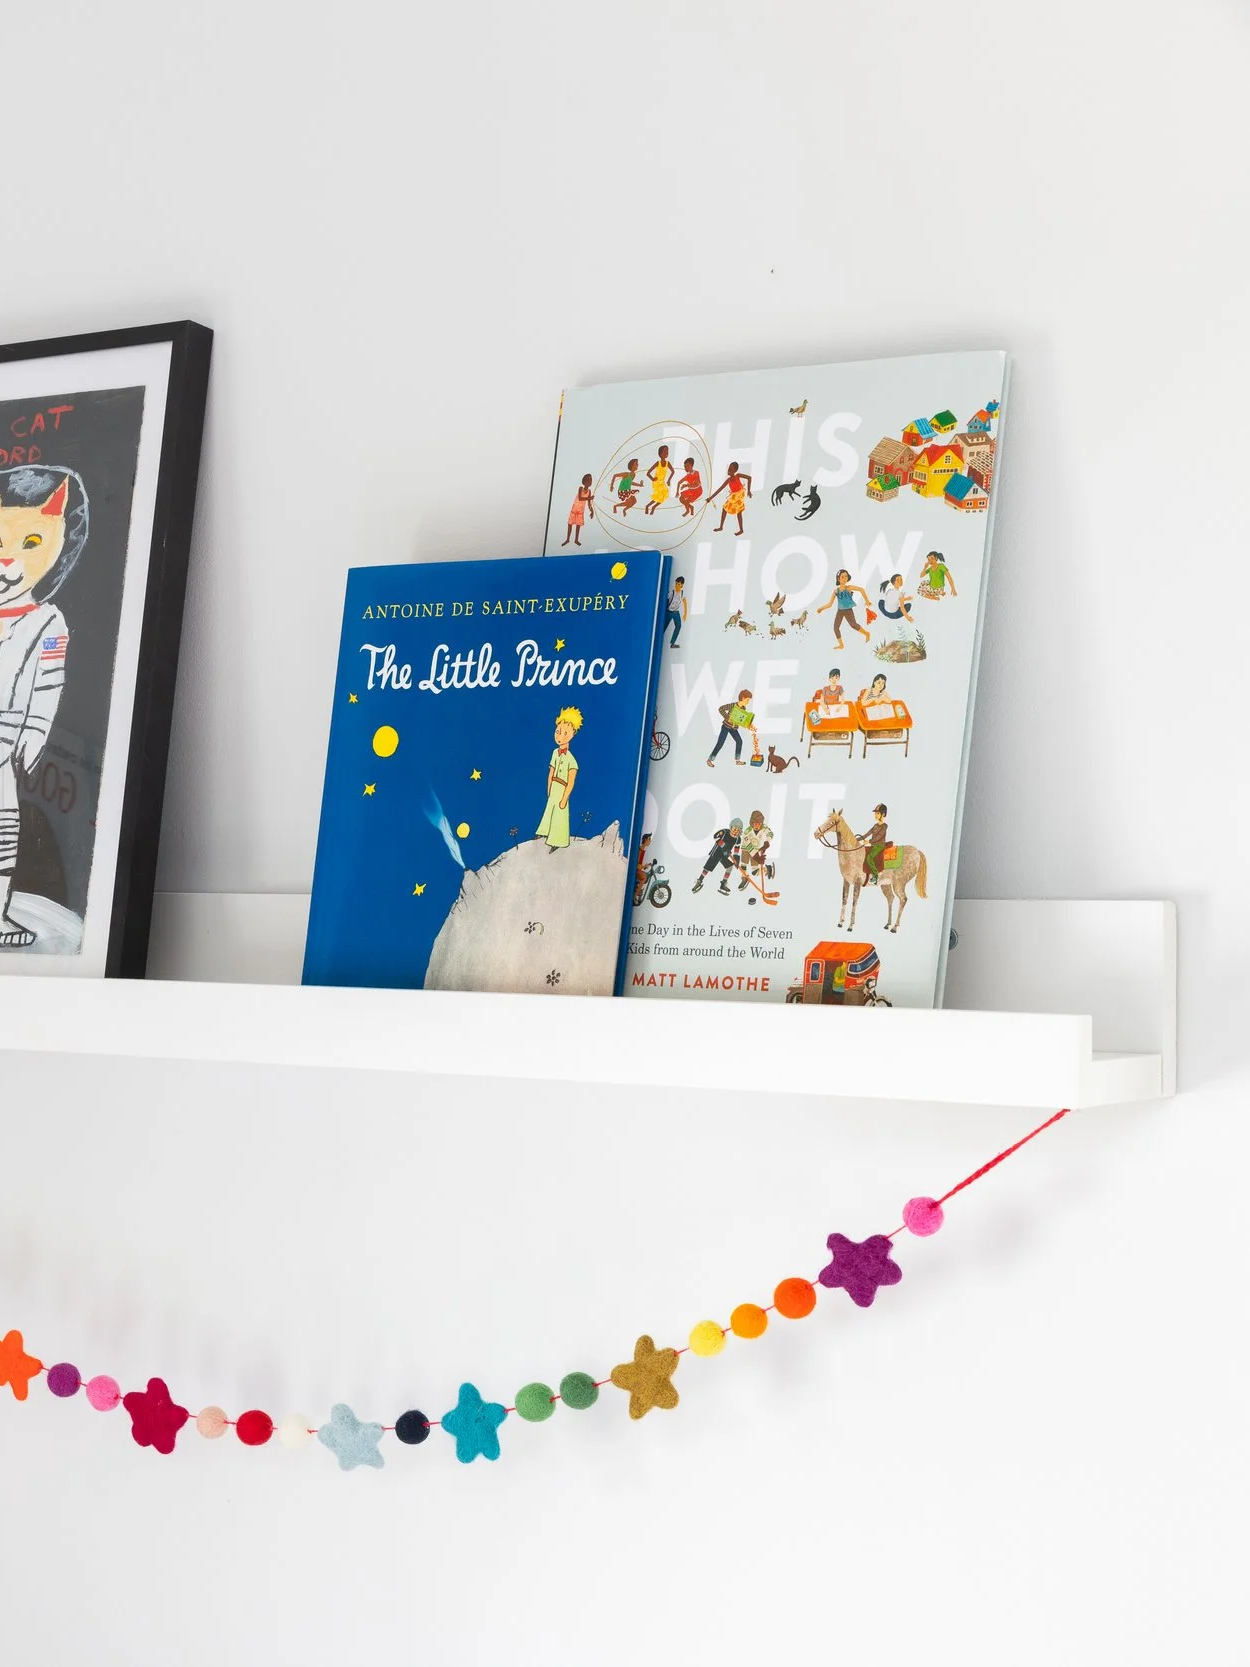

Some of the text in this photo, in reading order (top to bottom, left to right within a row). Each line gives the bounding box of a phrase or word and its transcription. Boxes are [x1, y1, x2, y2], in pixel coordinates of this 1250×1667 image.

[10, 404, 74, 438] CAT
[662, 411, 864, 498] THIS
[691, 530, 924, 618] HOW
[362, 592, 630, 620] ANTOINE DE SAINT-EXUPÉRY
[359, 639, 619, 695] The Little Prince
[671, 659, 799, 737] WE
[765, 783, 846, 859] IT
[627, 942, 785, 960] Kids from around the World
[630, 923, 793, 940] ne Day in the Lives of Seven
[632, 972, 770, 992] MATT LAMOTHE
